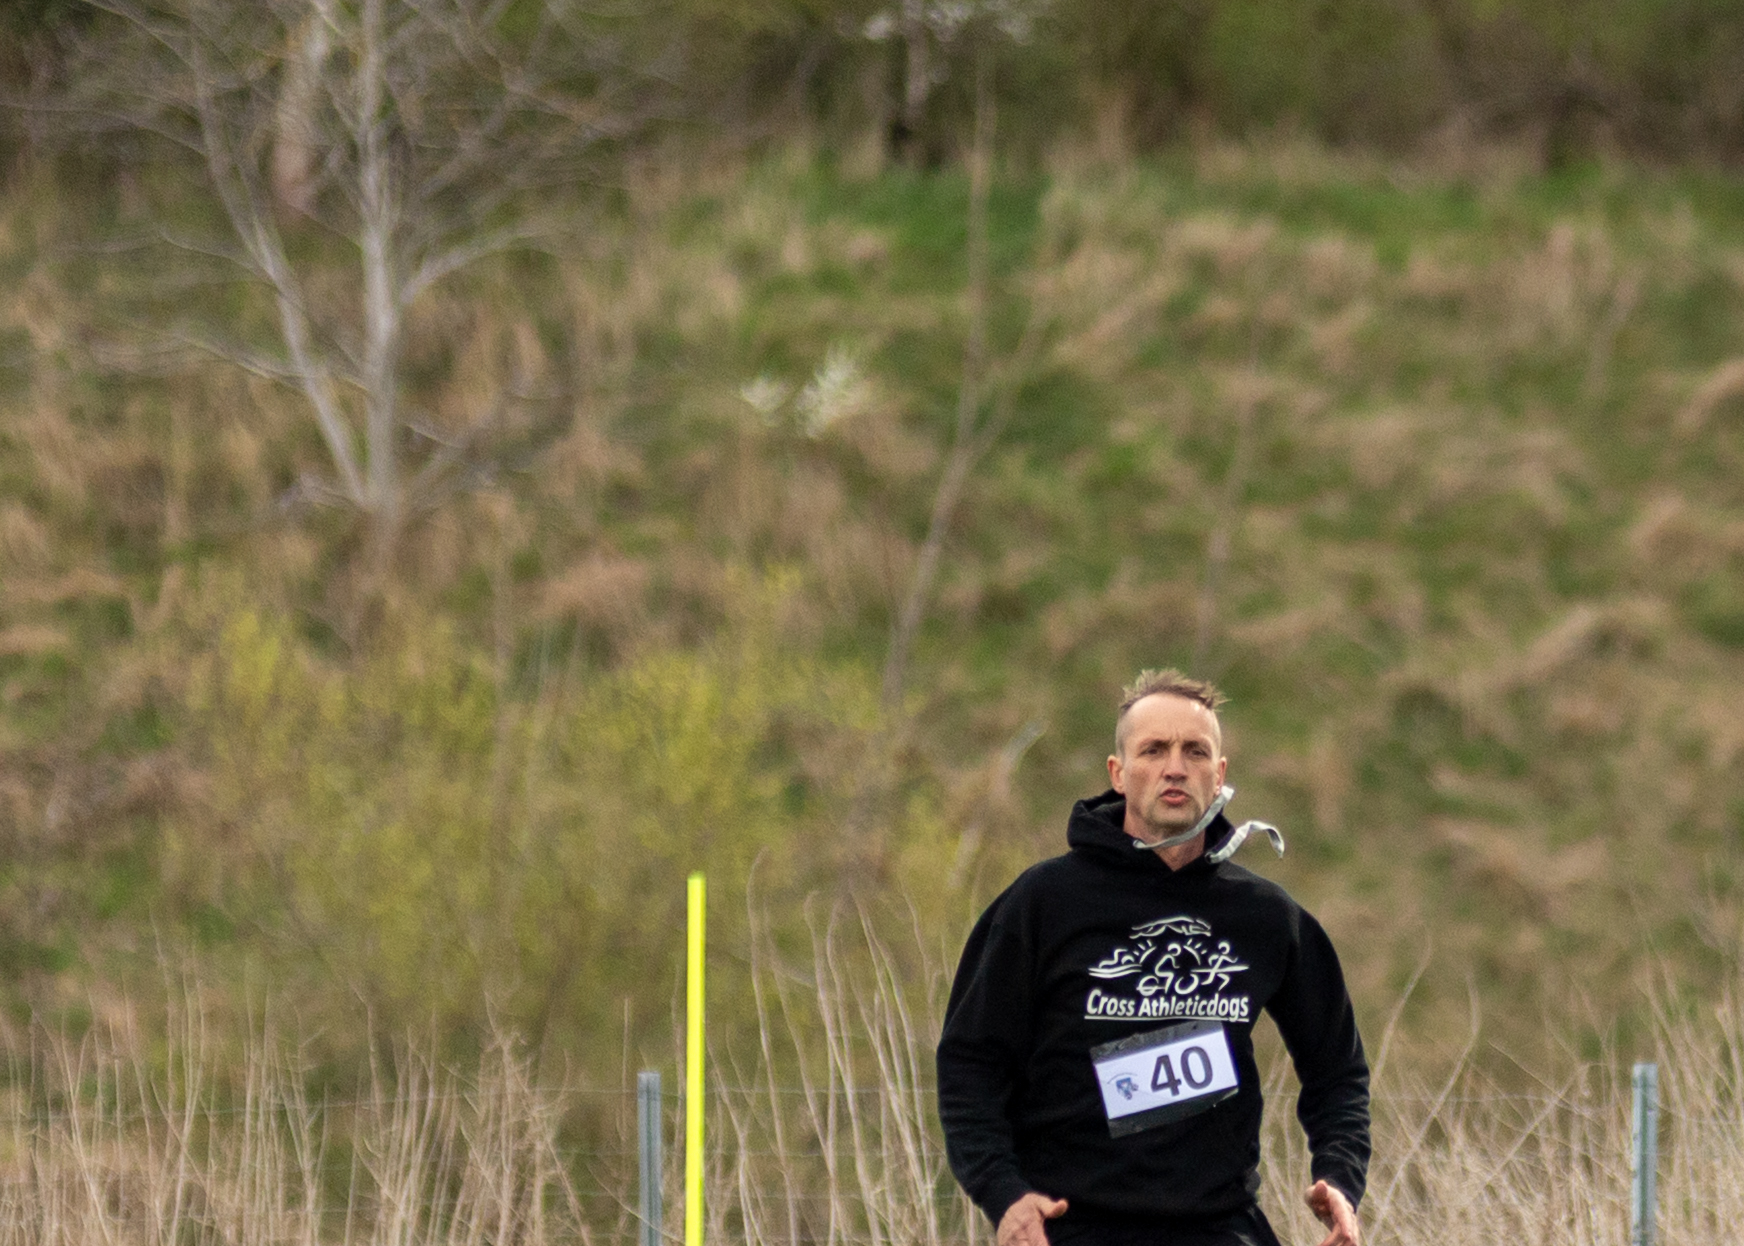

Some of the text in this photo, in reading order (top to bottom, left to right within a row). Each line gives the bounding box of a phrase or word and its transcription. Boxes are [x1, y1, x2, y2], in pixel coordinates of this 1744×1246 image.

[1088, 989, 1249, 1022] Cross Athleticdogs
[1151, 1046, 1213, 1097] 40
